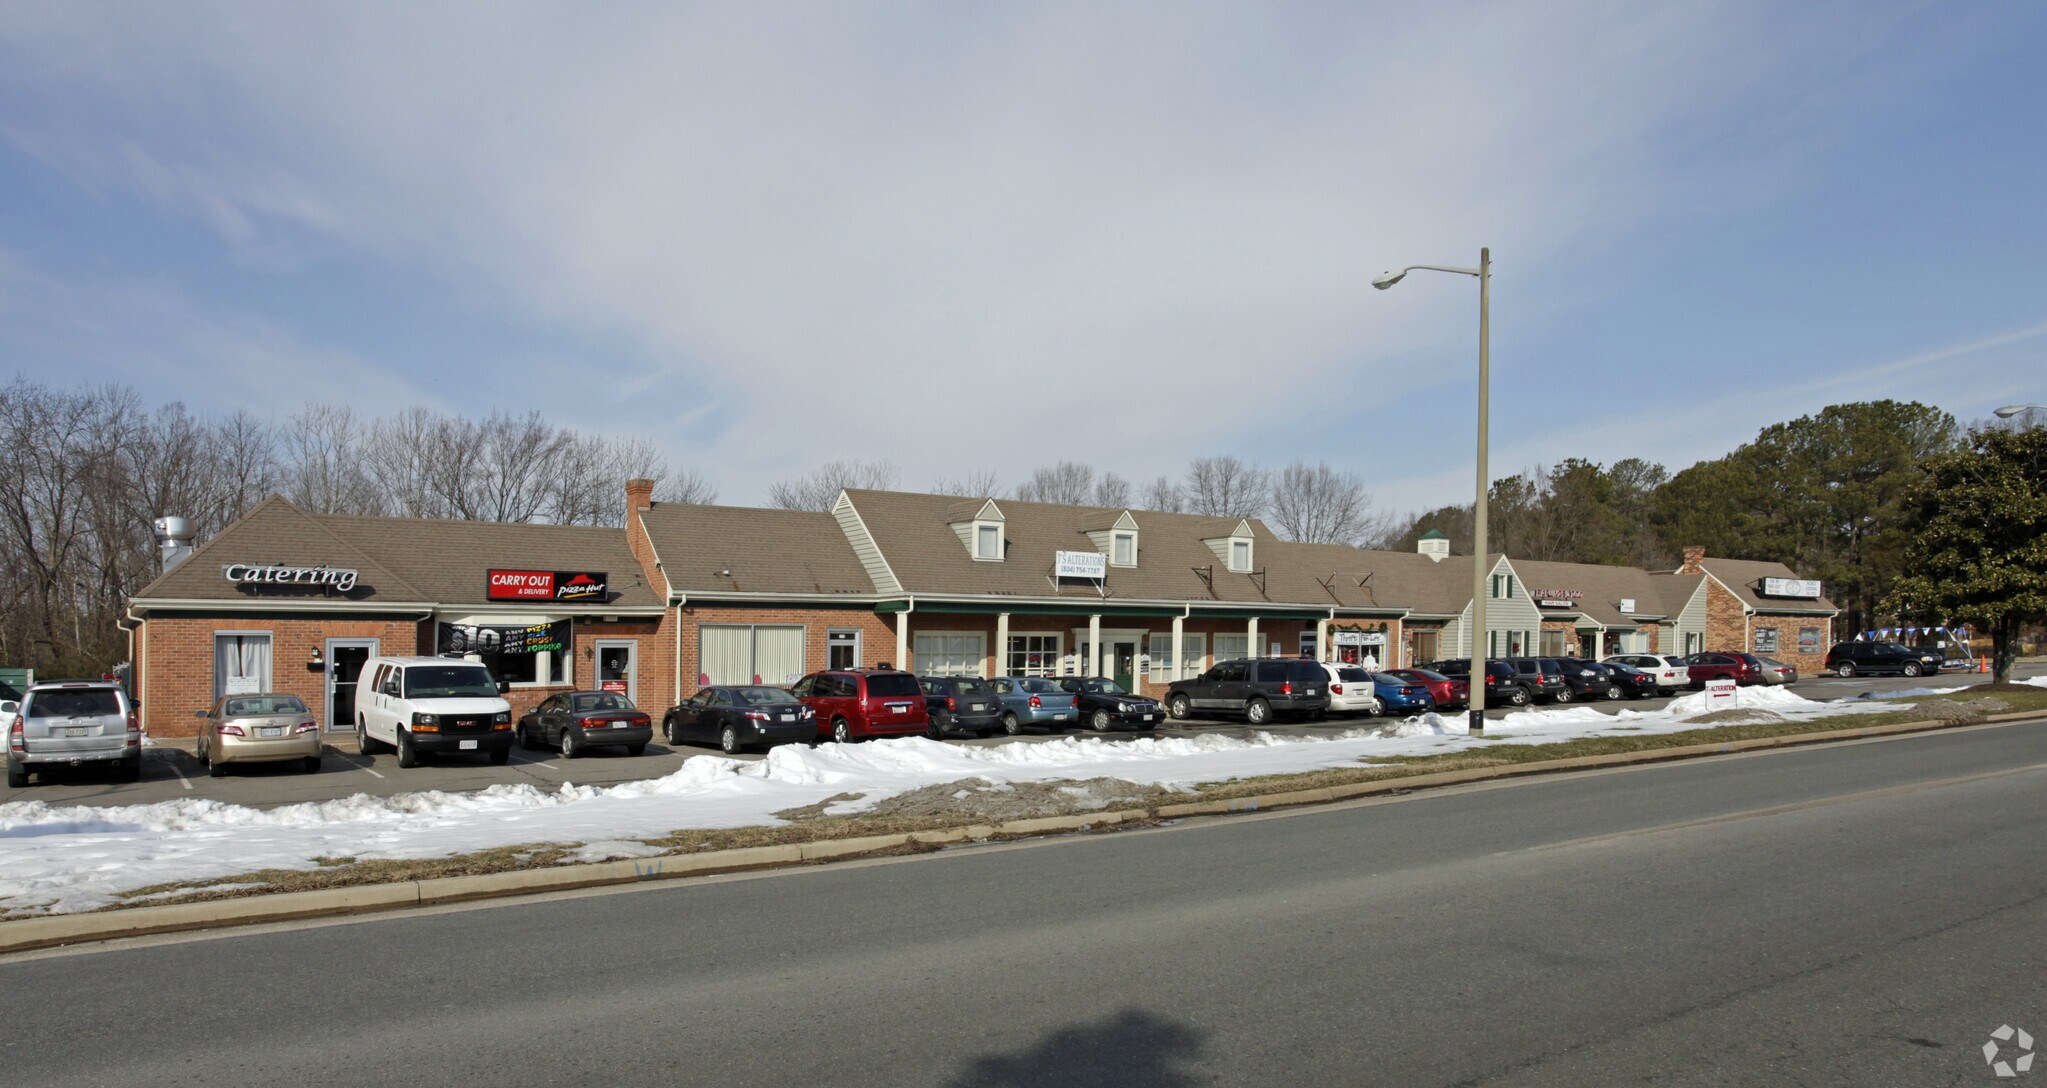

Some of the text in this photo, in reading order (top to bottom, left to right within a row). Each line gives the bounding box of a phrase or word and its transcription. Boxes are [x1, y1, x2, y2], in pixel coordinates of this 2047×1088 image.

[1067, 554, 1105, 566] ALTERATIONS
[225, 563, 358, 591] Catering
[491, 574, 550, 587] CARRY OUT
[586, 583, 605, 593] Hut
[526, 623, 552, 633] PIZZA
[450, 626, 500, 655] $10
[505, 634, 525, 642] ANY
[526, 636, 554, 645] CRUST
[527, 642, 562, 652] TOPPING
